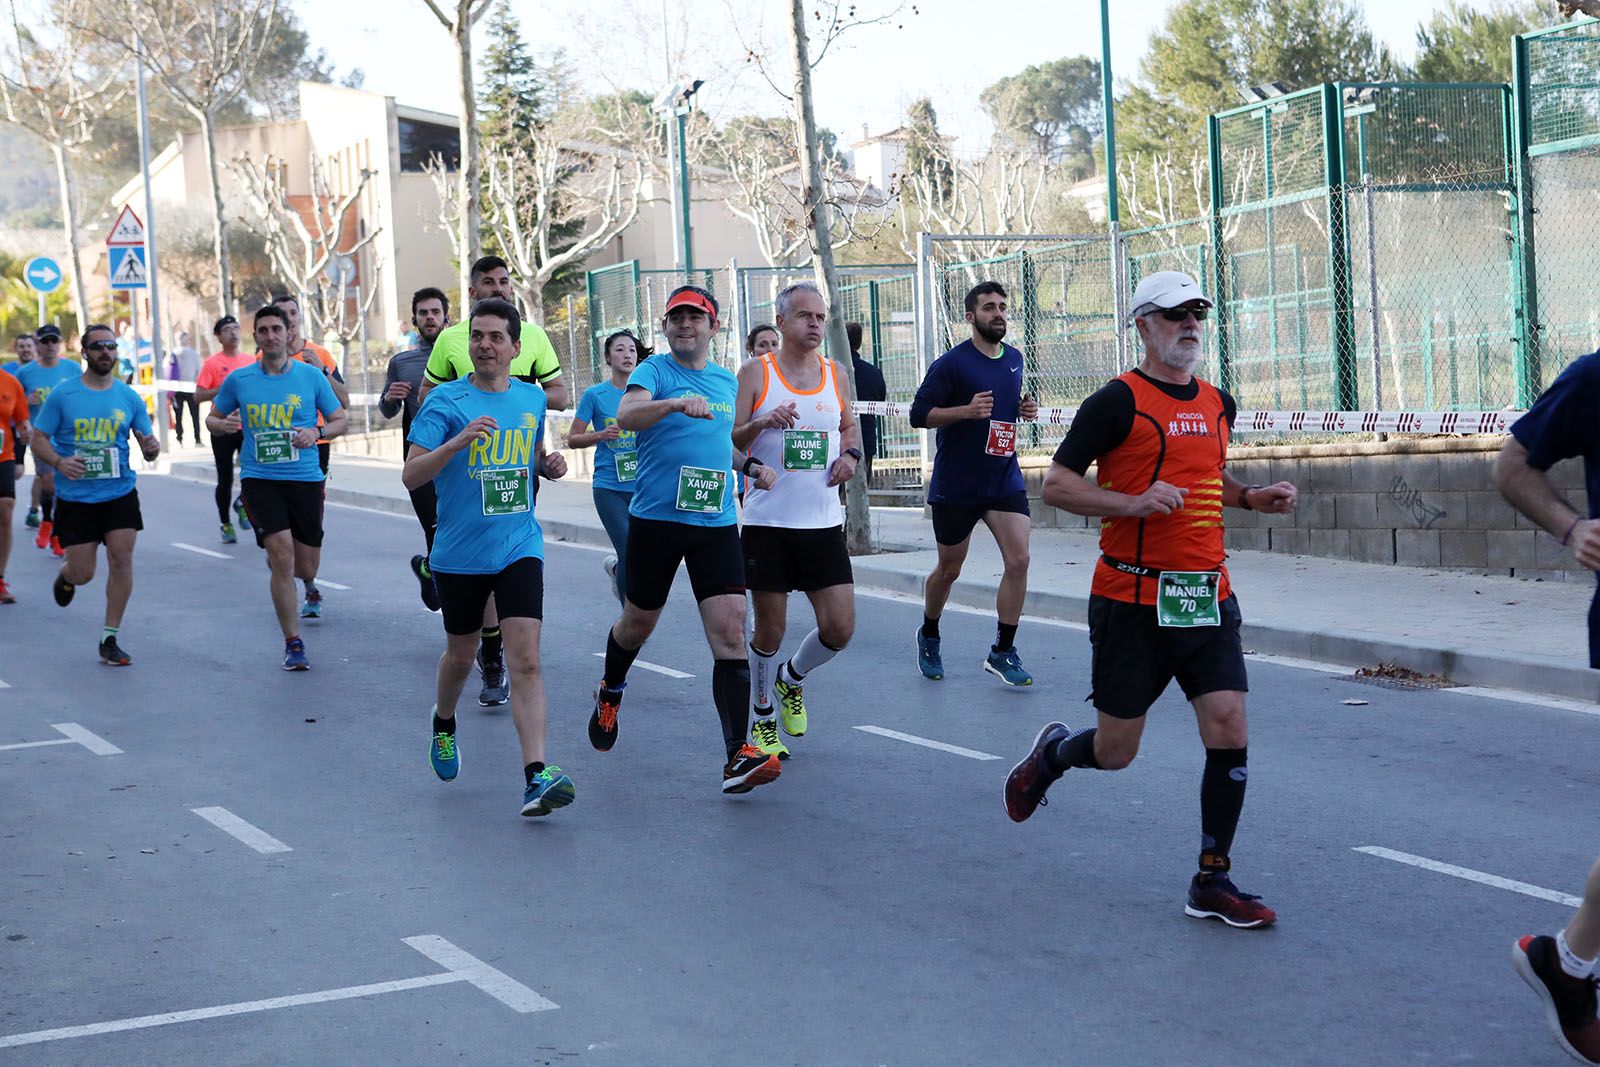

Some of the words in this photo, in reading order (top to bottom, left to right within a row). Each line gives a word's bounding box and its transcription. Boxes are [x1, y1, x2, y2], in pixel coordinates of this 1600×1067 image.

[246, 403, 294, 429] RUN
[73, 417, 120, 443] RUN
[995, 430, 1014, 439] VICTOR
[468, 429, 533, 467] RUN
[791, 440, 822, 449] JAUME
[998, 438, 1010, 448] 527
[265, 447, 281, 456] 109
[800, 450, 814, 460] 89
[87, 463, 103, 471] 110
[495, 480, 519, 491] LLUIS
[687, 478, 719, 490] XAVIER
[501, 491, 515, 503] 87
[695, 490, 709, 501] 84
[1117, 562, 1149, 575] 2XU
[1165, 585, 1211, 597] MANUEL
[1180, 599, 1197, 612] 70
